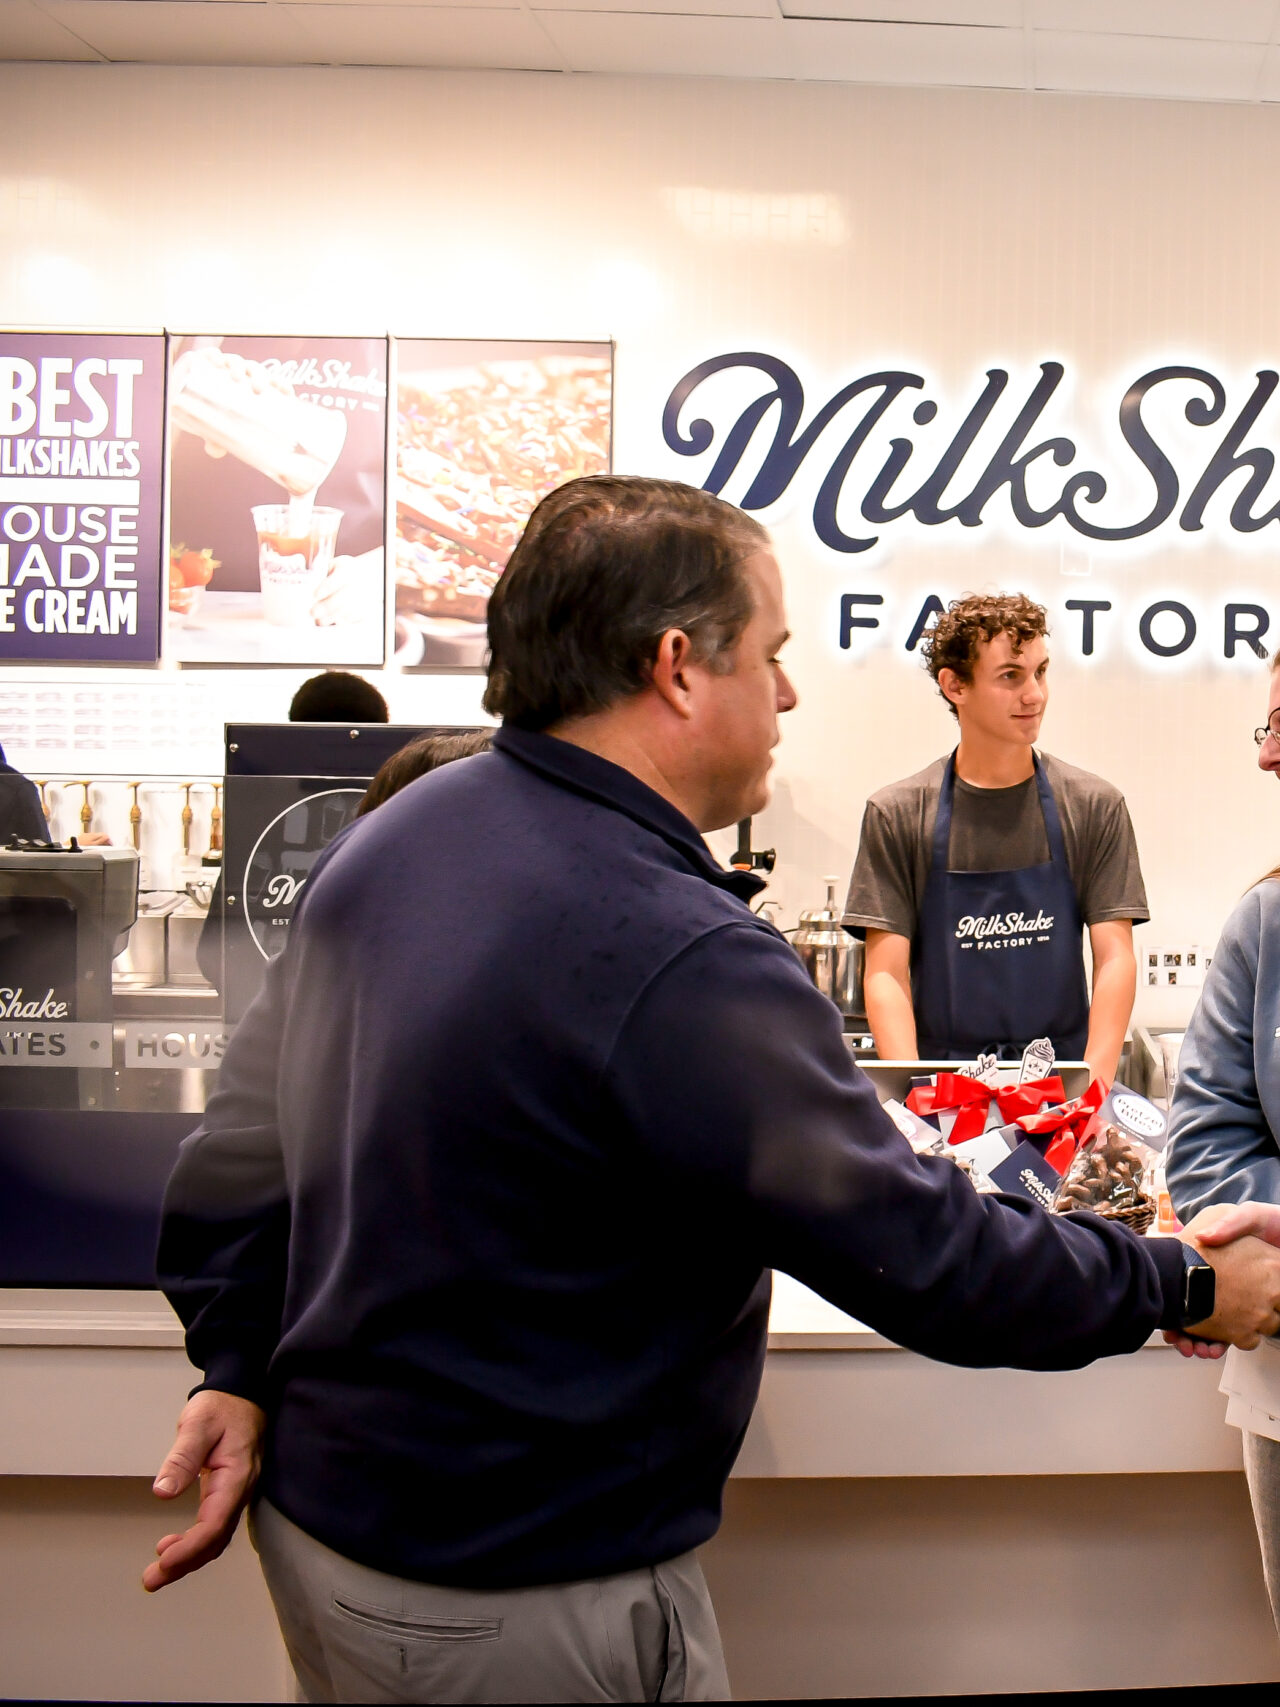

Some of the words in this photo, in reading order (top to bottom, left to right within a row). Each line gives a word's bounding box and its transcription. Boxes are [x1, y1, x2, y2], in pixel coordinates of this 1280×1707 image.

[0, 356, 143, 438] BEST
[0, 438, 140, 477] LKSHAKES
[3, 504, 139, 543] OUSE
[0, 543, 138, 589] ADE
[25, 588, 138, 636] CREAM
[955, 909, 1054, 939] MilkShake
[977, 937, 1032, 950] FACTORY
[0, 987, 68, 1018] Shake
[137, 1032, 228, 1059] HOUS
